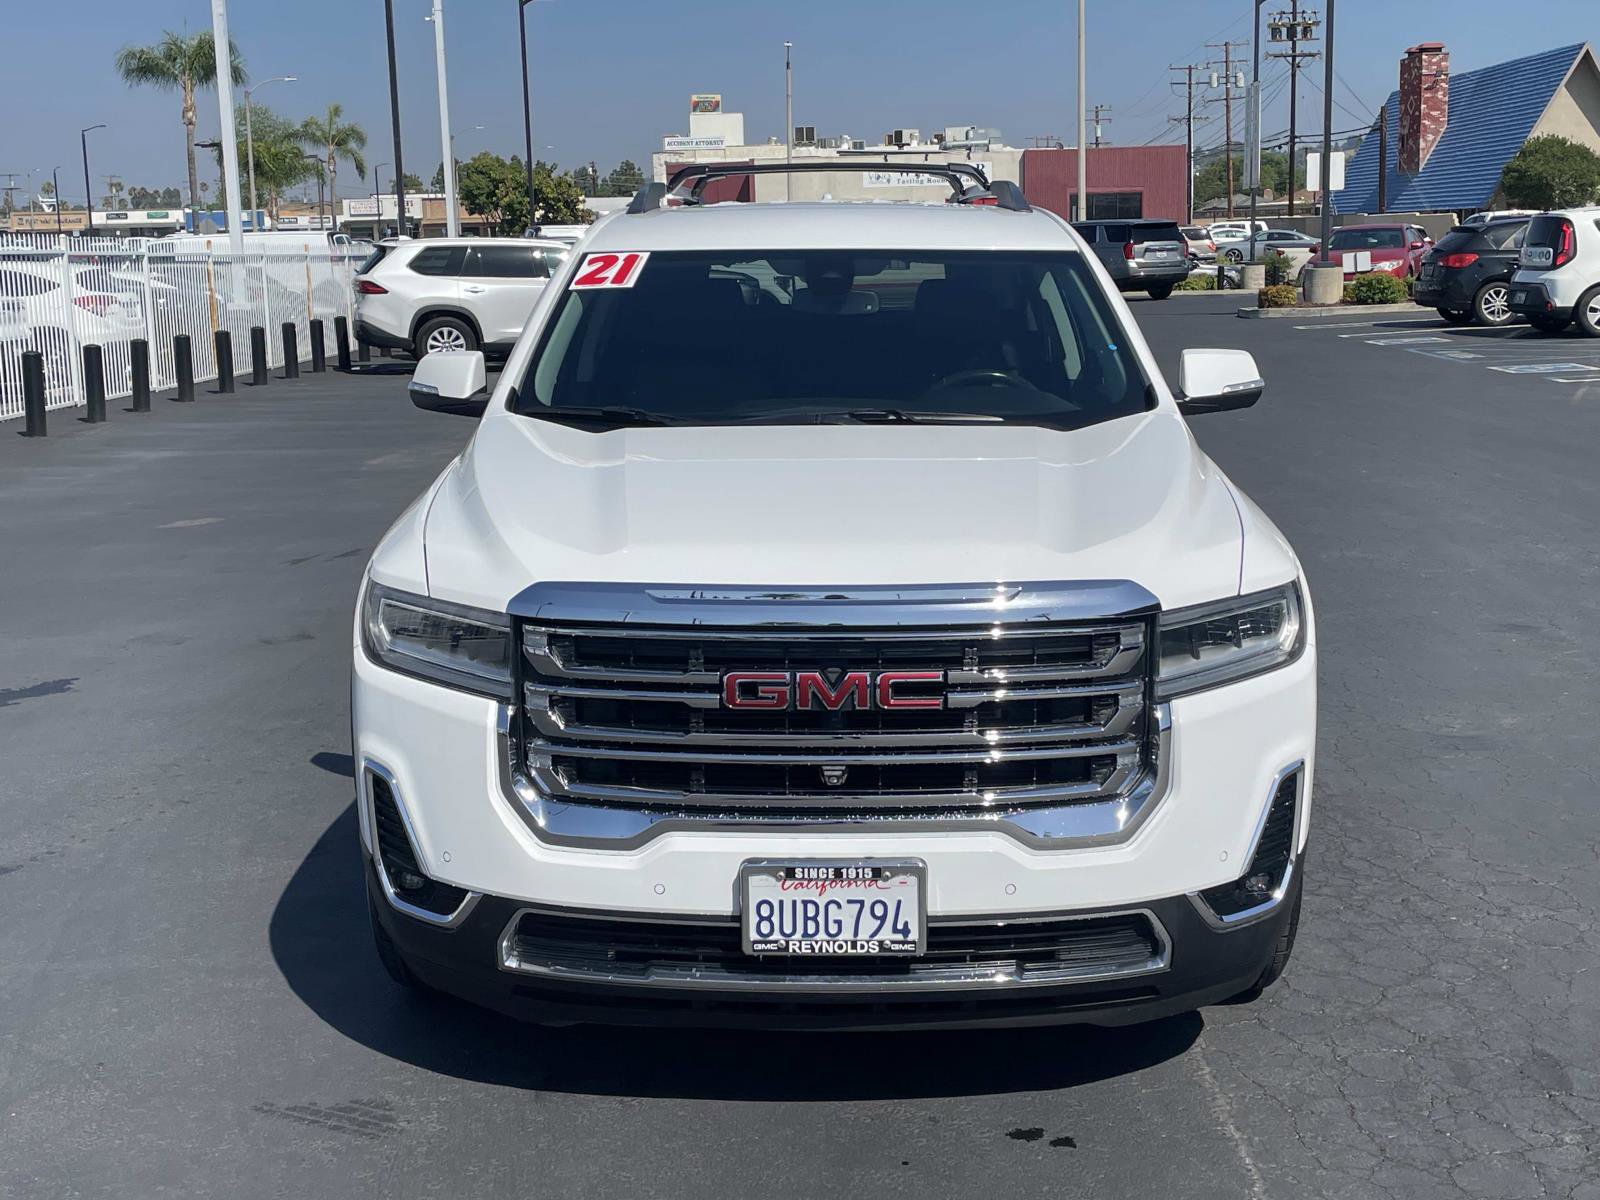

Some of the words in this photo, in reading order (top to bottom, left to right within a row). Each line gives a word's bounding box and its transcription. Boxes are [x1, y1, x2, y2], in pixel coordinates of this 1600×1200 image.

[574, 253, 641, 286] 21
[723, 671, 944, 710] GMC
[794, 867, 835, 879] SINCE
[840, 867, 873, 879] 1915
[755, 899, 911, 939] 8UBG794
[788, 940, 880, 953] REYNOLDS
